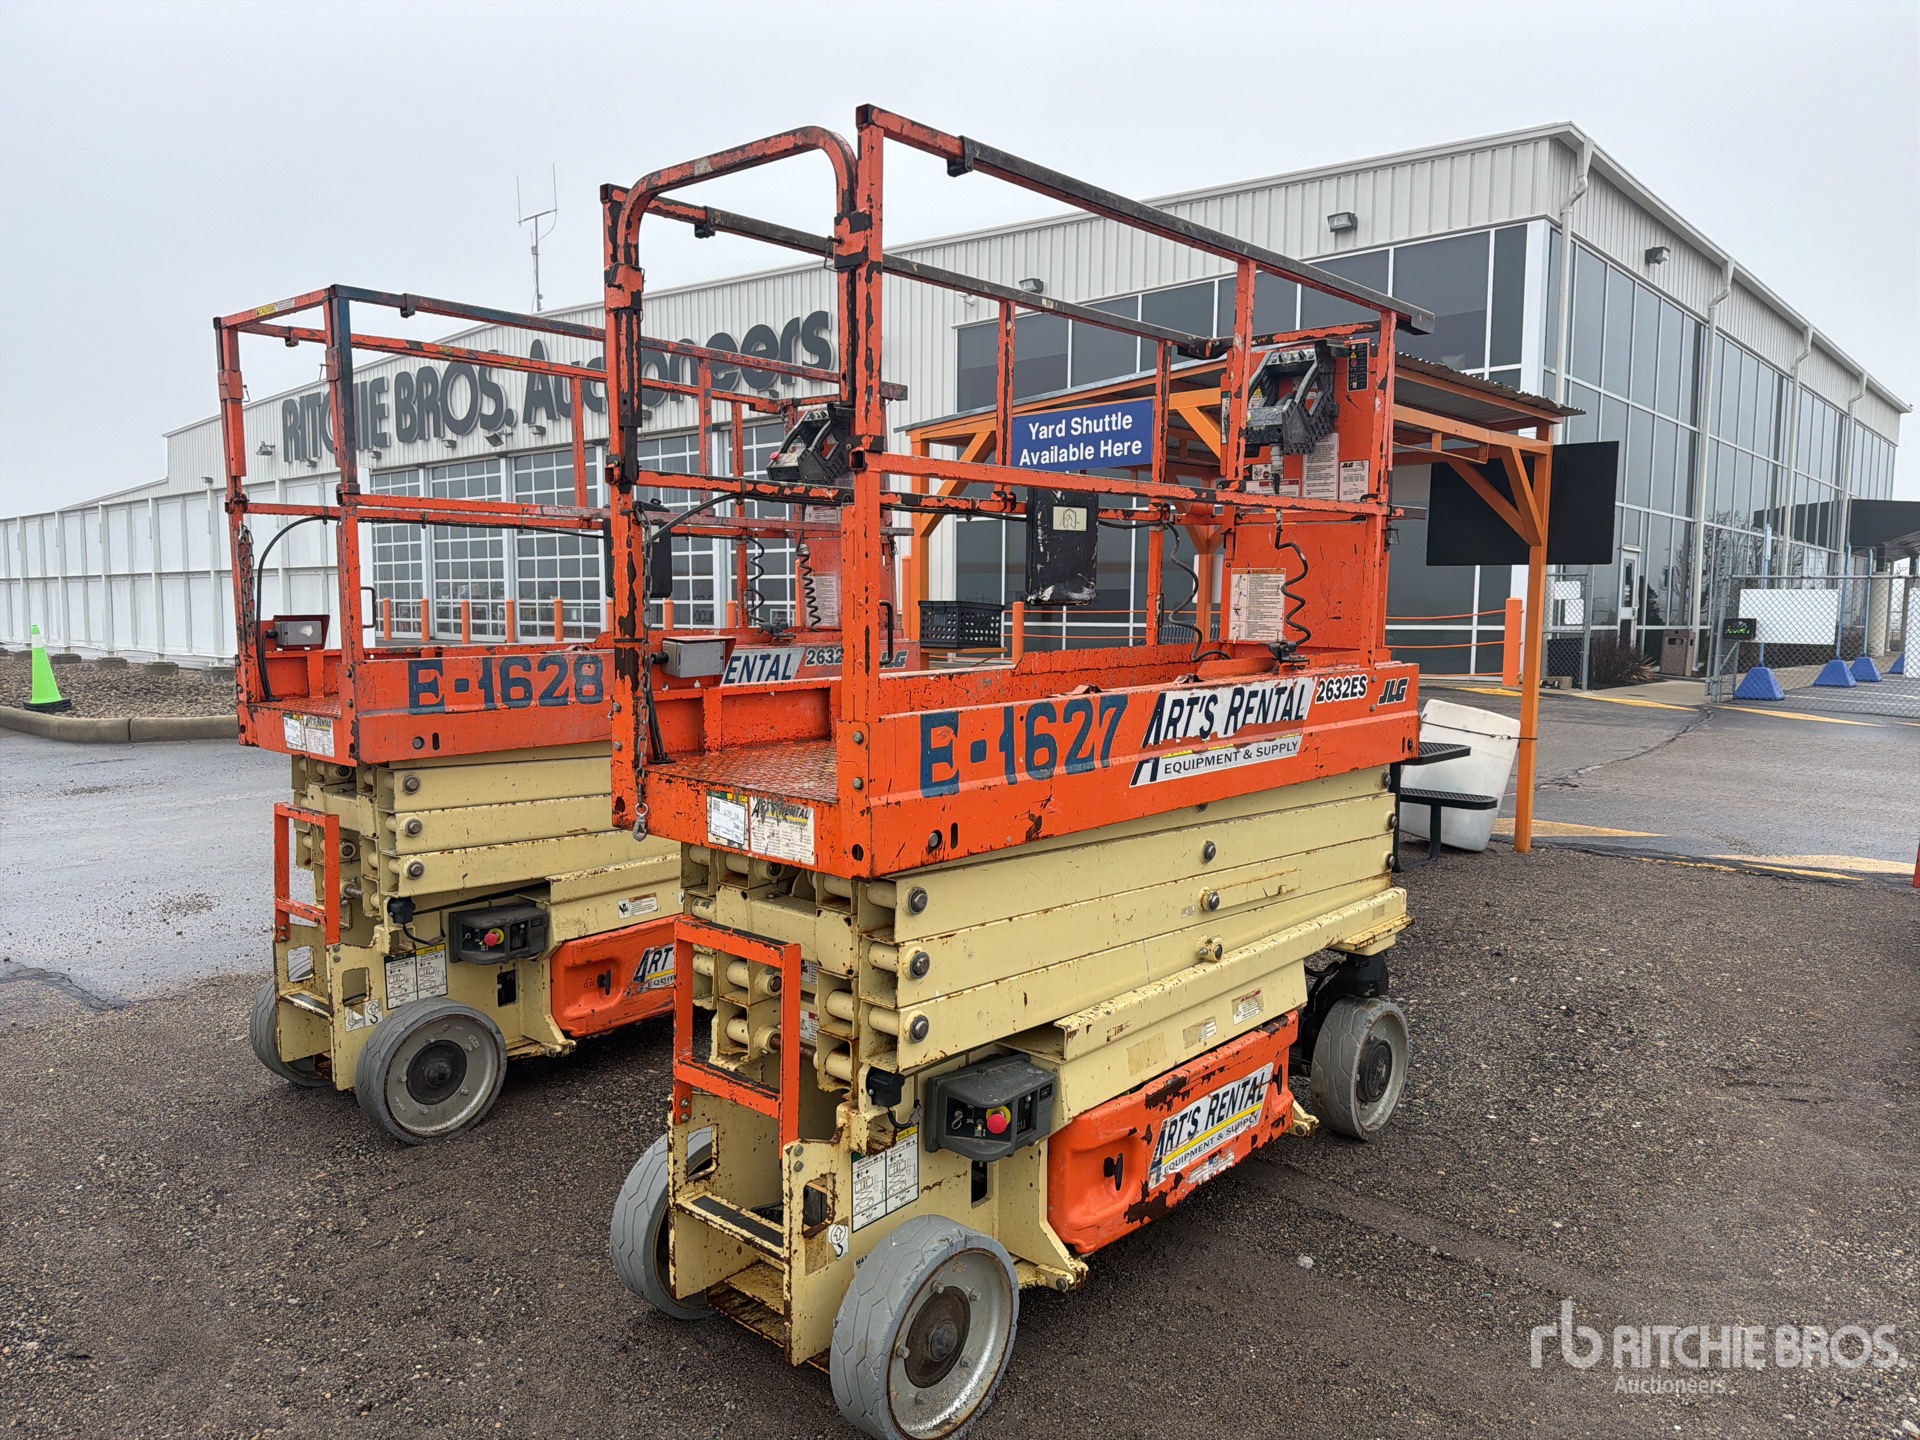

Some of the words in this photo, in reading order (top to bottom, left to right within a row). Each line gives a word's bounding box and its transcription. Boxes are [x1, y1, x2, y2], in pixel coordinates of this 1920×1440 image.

[281, 376, 391, 462] RITCIE
[394, 349, 517, 443] BROS.
[522, 311, 835, 424] Auconeers
[1029, 419, 1066, 440] Yard
[1070, 411, 1133, 436] Shuttle
[1019, 443, 1095, 466] Available
[1100, 439, 1142, 458] Here
[723, 653, 792, 684] ENTAL
[805, 648, 843, 666] 2632
[1317, 675, 1368, 702] 2632ES
[1378, 678, 1408, 705] JLG
[1223, 683, 1308, 735] RENTAL
[1164, 751, 1239, 775] EQUIPMENT
[1243, 749, 1253, 760] &
[1256, 740, 1300, 758] SUPPLY
[632, 946, 675, 984] ART
[647, 975, 678, 989] EQUIP
[1149, 1105, 1201, 1183] ART'S
[1204, 1072, 1266, 1132] RENTAL
[1164, 1137, 1215, 1174] EQUIPMENT
[1216, 1132, 1224, 1140] &
[1225, 1112, 1260, 1136] SUPPLY
